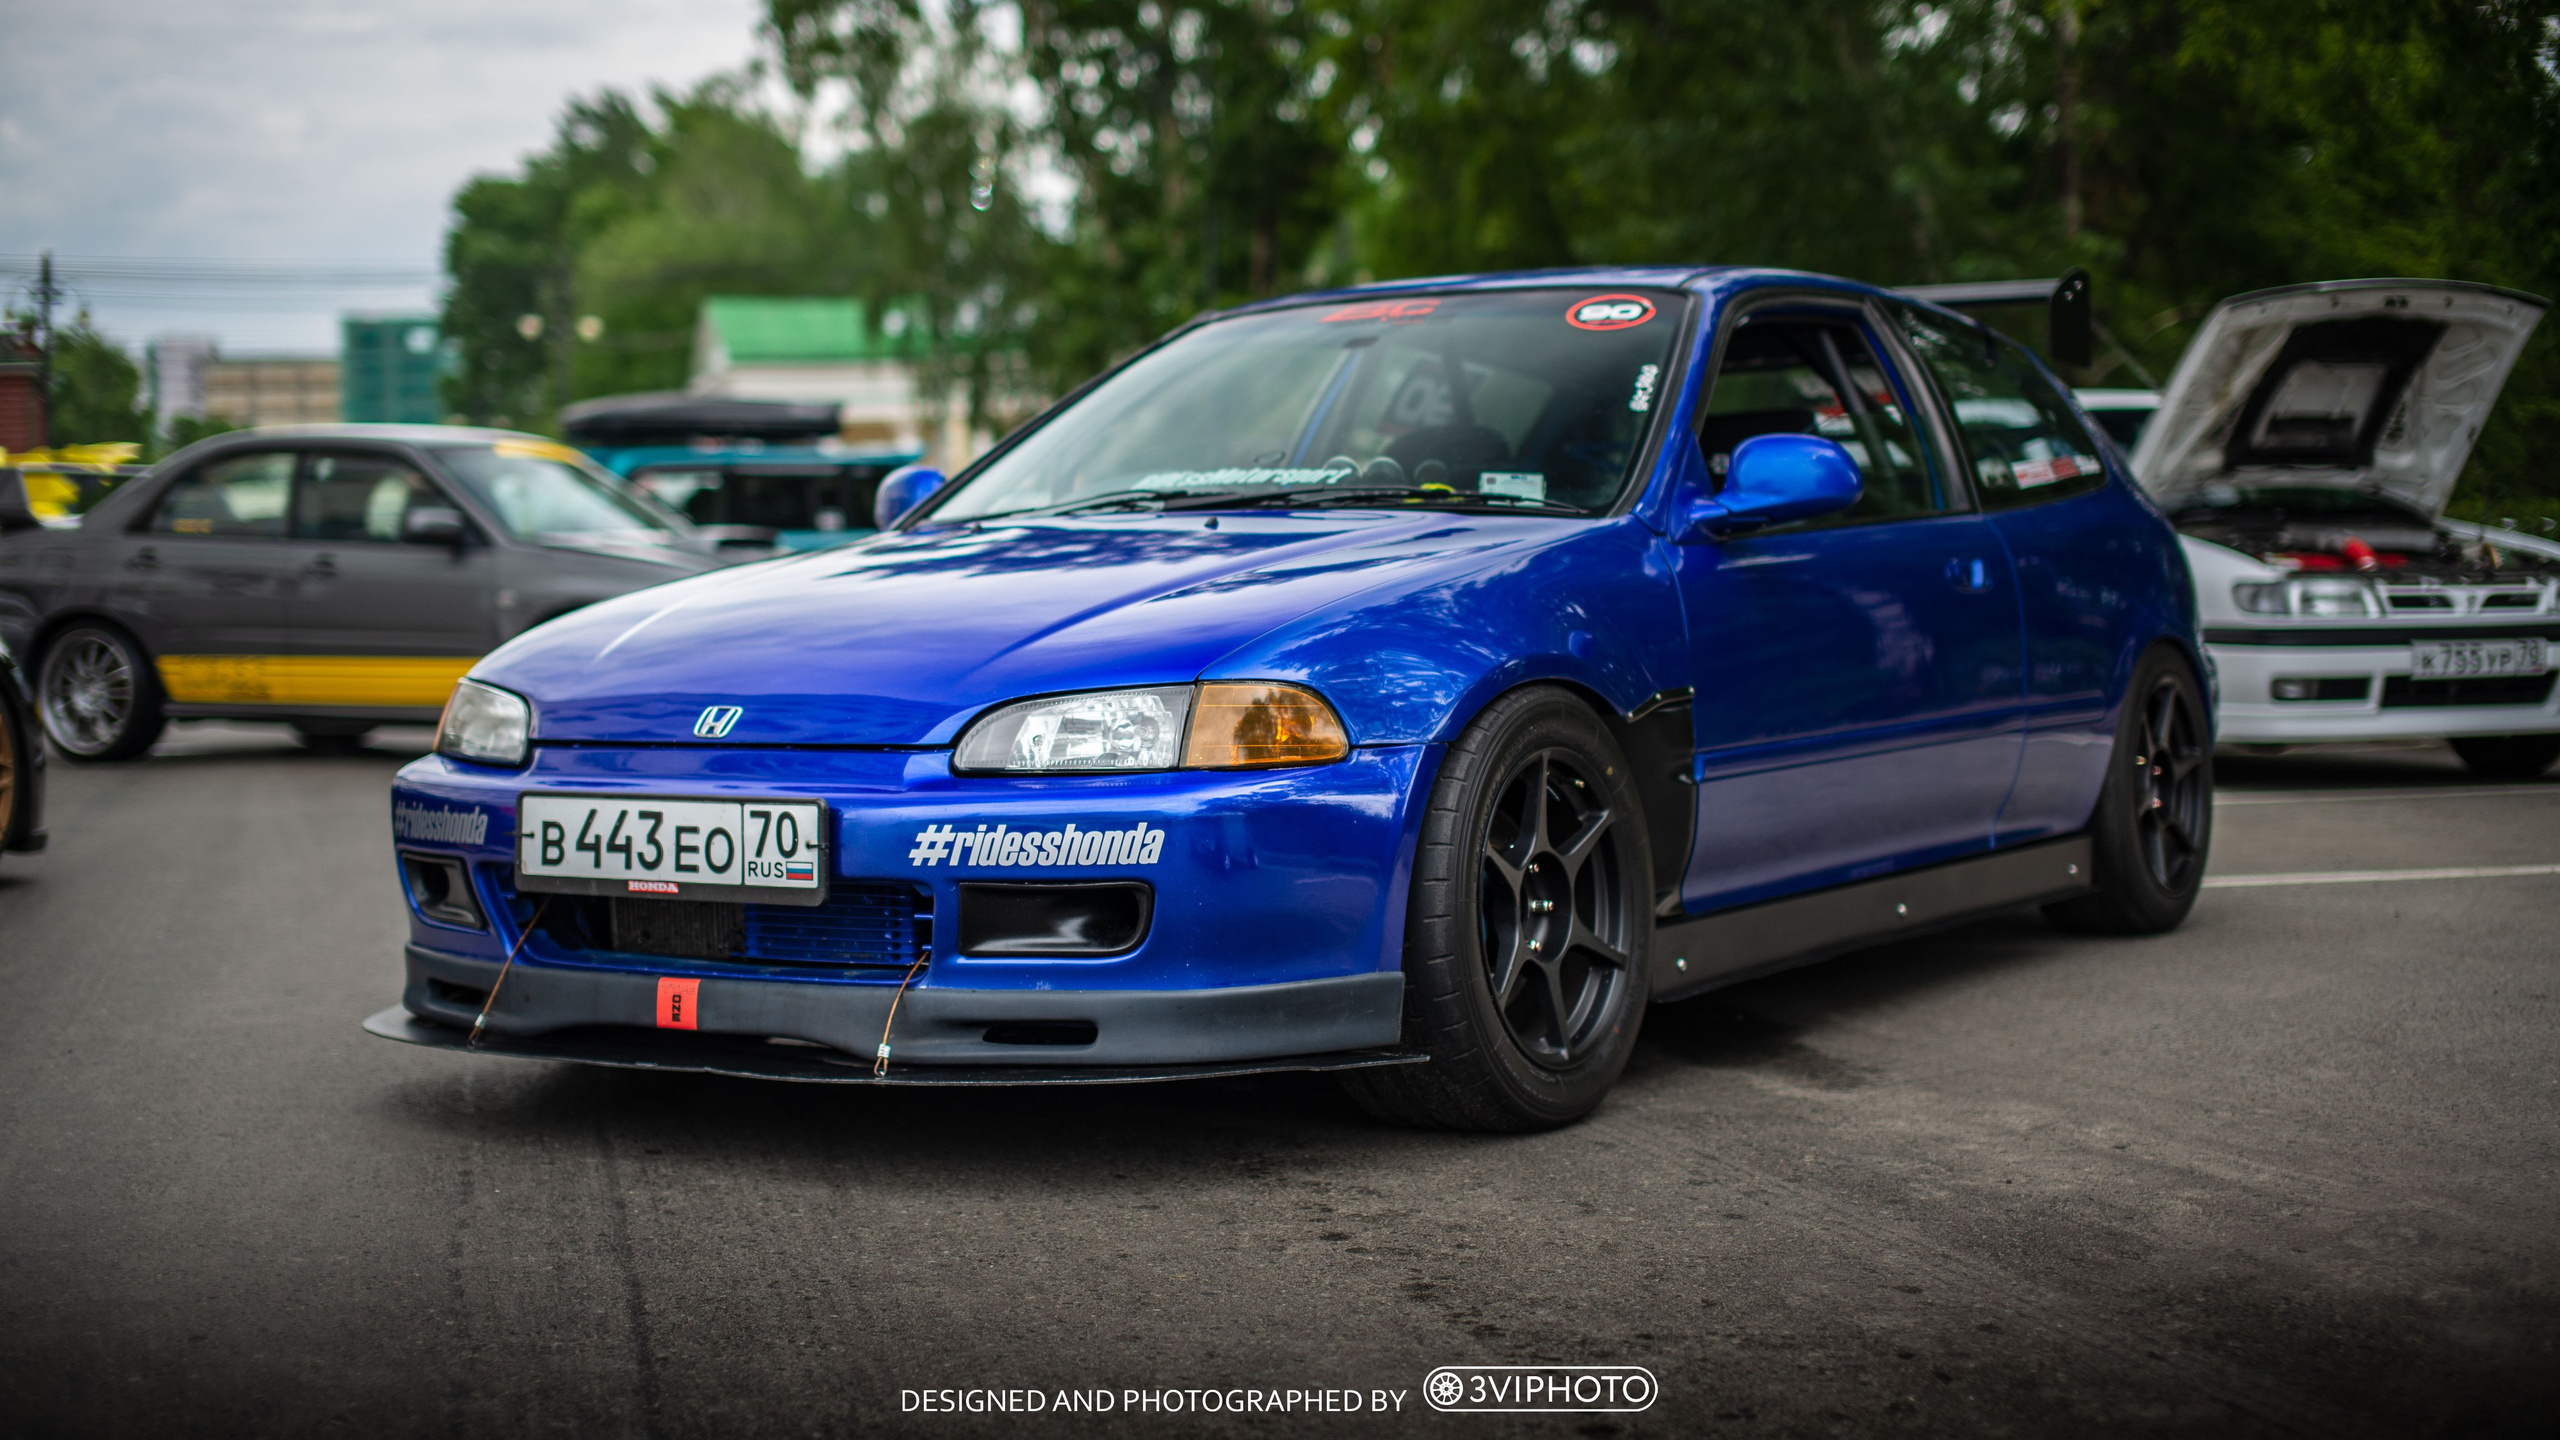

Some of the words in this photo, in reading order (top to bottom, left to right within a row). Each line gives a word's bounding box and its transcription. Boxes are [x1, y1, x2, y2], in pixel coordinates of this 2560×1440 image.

[749, 810, 799, 859] 70
[908, 822, 1166, 866] #ridesshonda
[748, 861, 784, 878] RUS
[629, 880, 679, 894] HONDA
